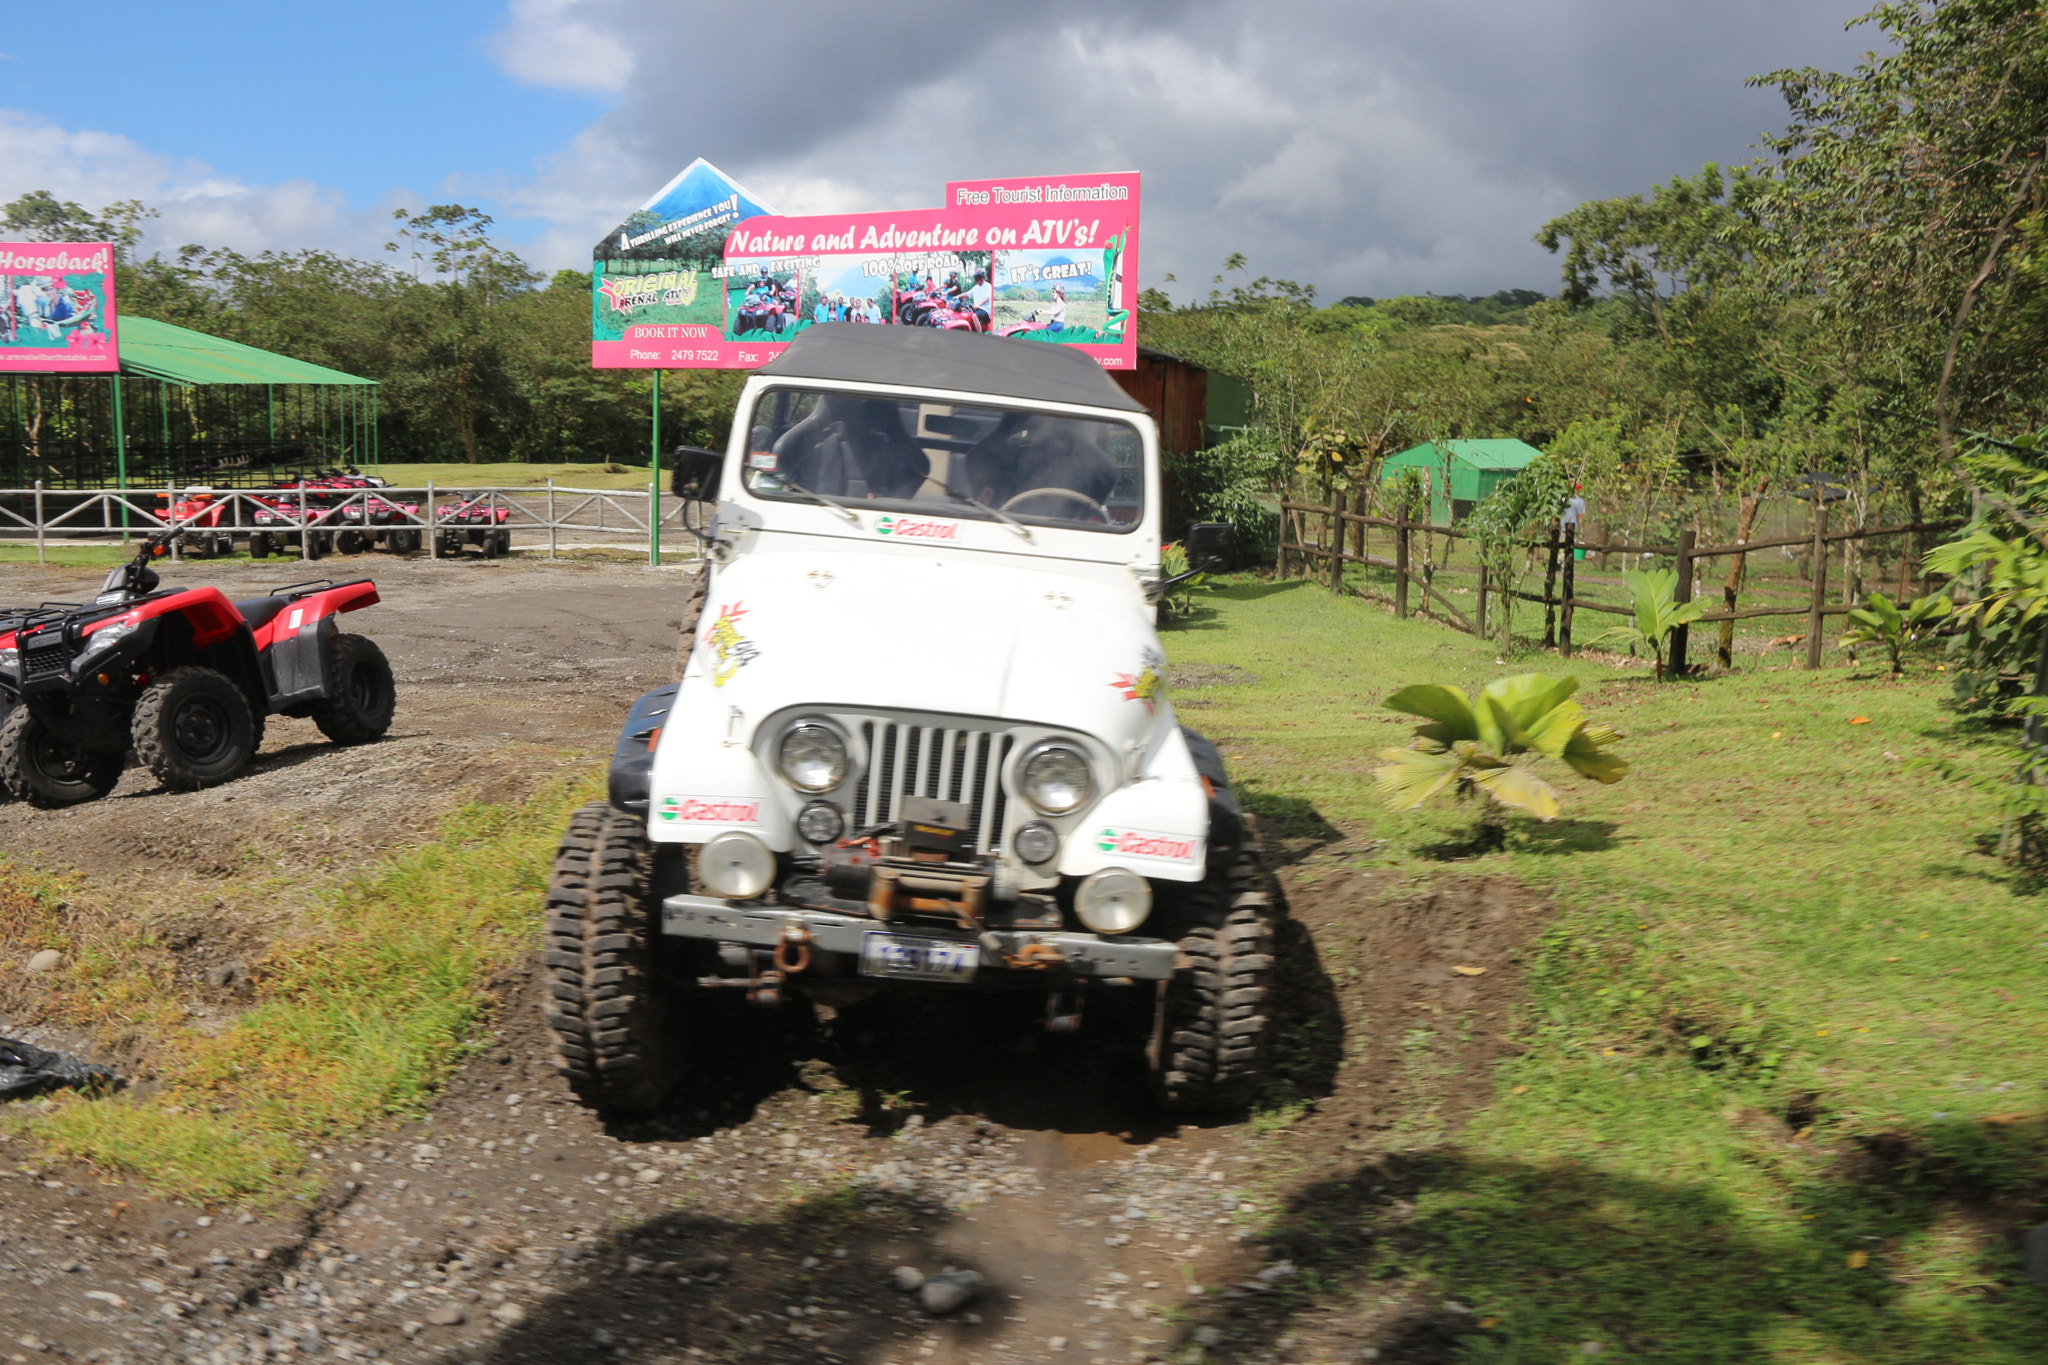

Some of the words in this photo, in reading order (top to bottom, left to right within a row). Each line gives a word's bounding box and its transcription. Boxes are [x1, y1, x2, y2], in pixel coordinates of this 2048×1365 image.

[957, 189, 990, 204] Free
[993, 186, 1042, 203] Tourist
[1045, 184, 1128, 201] Information
[620, 232, 630, 251] A
[668, 207, 712, 233] EXPERIENCE
[664, 234, 682, 245] WILL
[682, 223, 704, 238] NEVER
[704, 212, 731, 230] FORGET
[728, 230, 805, 253] Nature
[811, 225, 856, 251] and
[859, 223, 978, 250] Adventure
[985, 227, 1017, 245] on
[1021, 218, 1100, 247] ATV's!
[711, 265, 735, 279] SAFE
[739, 263, 760, 276] AND
[769, 256, 820, 273] EXCITING
[862, 258, 902, 278] 100%
[904, 258, 925, 272] OFF
[926, 254, 959, 270] ROAD
[1010, 263, 1041, 284] IT'S
[1042, 261, 1092, 280] GREAT!
[612, 268, 697, 297] ORIGINAL
[619, 293, 658, 308] ARENAL
[634, 327, 664, 338] BOOK
[667, 327, 678, 338] IT
[681, 327, 707, 338] NOW
[630, 349, 661, 360] Phone:
[671, 350, 694, 360] 2479
[696, 350, 718, 361] 7522
[738, 351, 759, 362] Fax:
[895, 519, 958, 539] Castrol
[681, 799, 760, 821] Castrol
[1119, 832, 1196, 859] Castrol
